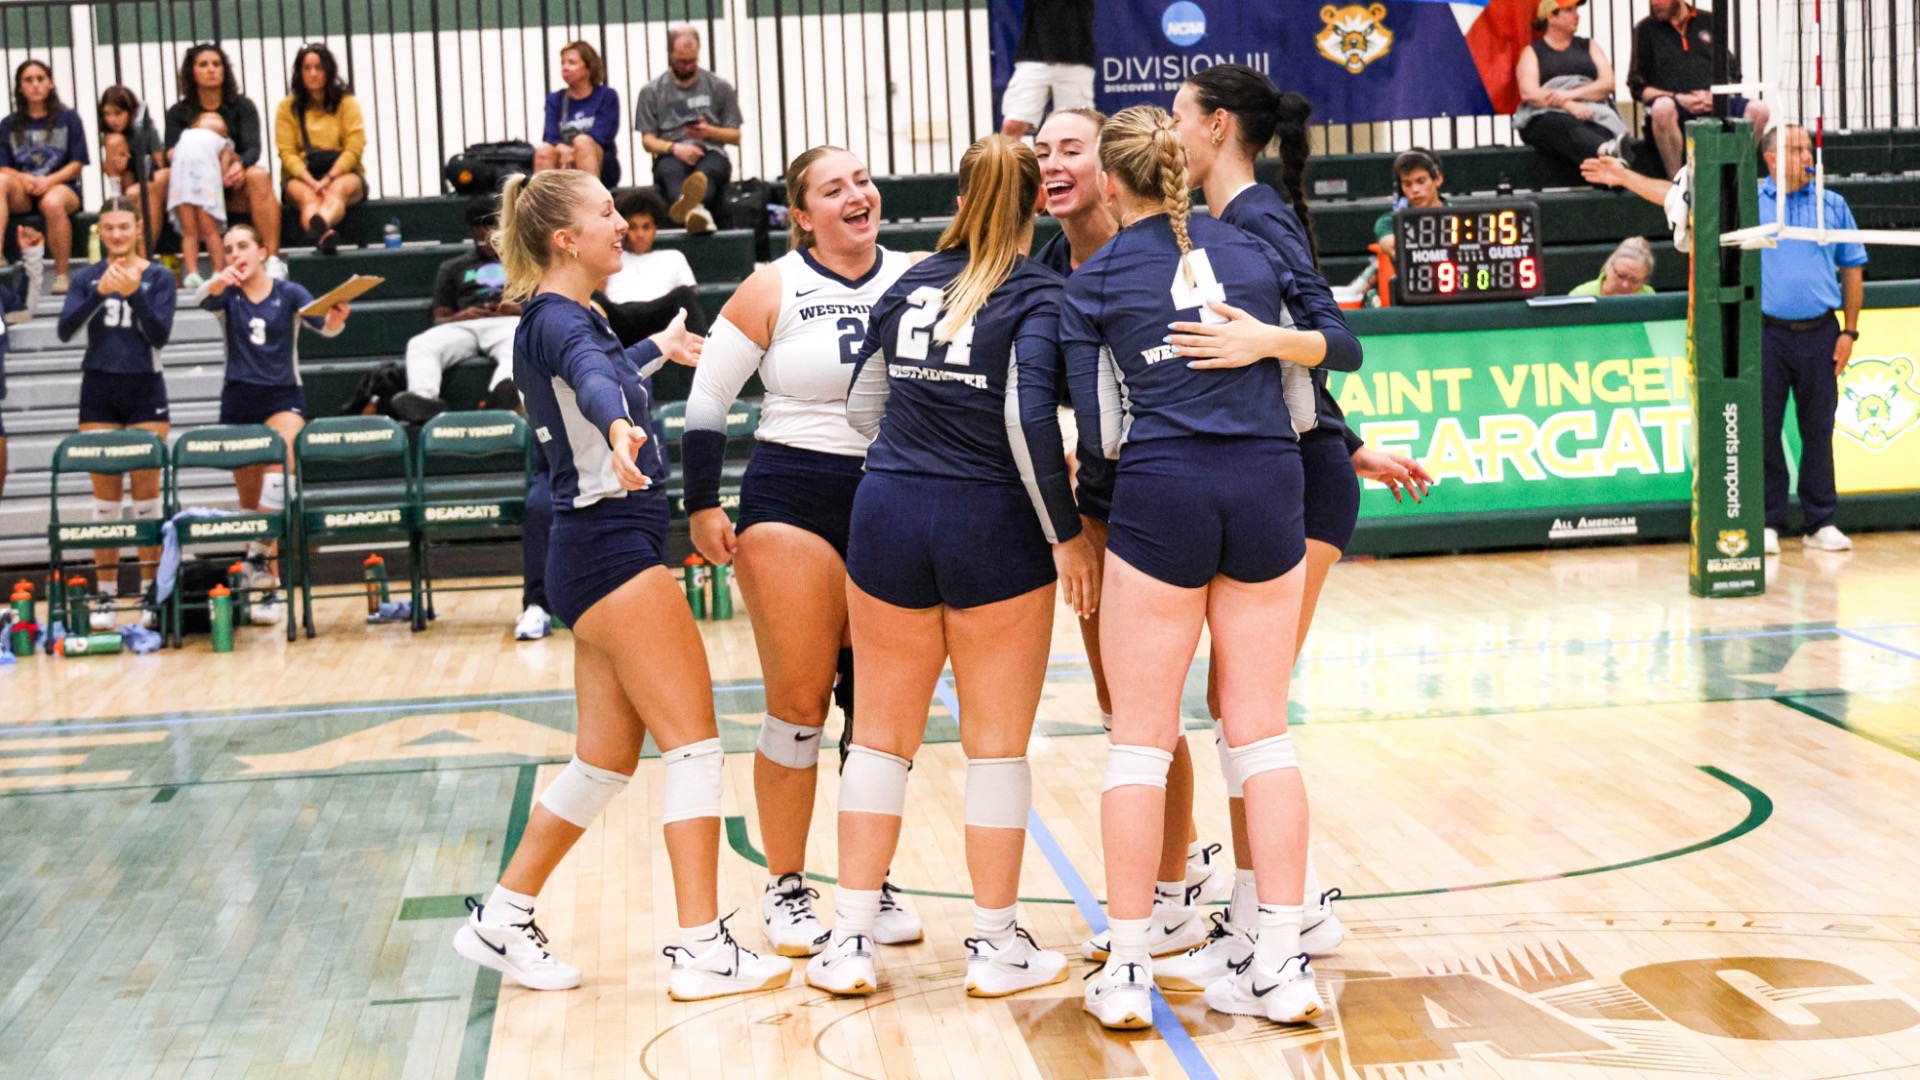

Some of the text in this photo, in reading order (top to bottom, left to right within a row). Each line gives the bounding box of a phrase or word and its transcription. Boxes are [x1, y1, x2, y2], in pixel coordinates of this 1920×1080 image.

[1166, 21, 1206, 36] NCAA
[1104, 82, 1156, 93] DISCOVER
[1450, 210, 1518, 245] 1:15
[1412, 249, 1449, 263] HOME
[1488, 245, 1530, 260] GUEST
[1437, 261, 1456, 293] 9
[1518, 257, 1537, 290] 5
[1170, 248, 1227, 325] 4
[103, 297, 133, 328] 31
[799, 304, 875, 321] WESTMI
[248, 317, 266, 346] 3
[895, 285, 976, 367] 24
[1326, 356, 1688, 417] AINT VINCE
[307, 429, 394, 444] SAINT VINCENT
[432, 424, 515, 438] SAINT VINCENT
[67, 444, 153, 457] SAINT VINCENT
[186, 437, 272, 452] SAINT VINCENT
[1359, 404, 1691, 490] EARCAT
[1722, 403, 1741, 519] sports imports
[324, 509, 401, 527] BEARCATS
[425, 505, 500, 520] BEARCATS
[59, 525, 137, 541] BEARCATS
[190, 520, 268, 536] BEARCATS
